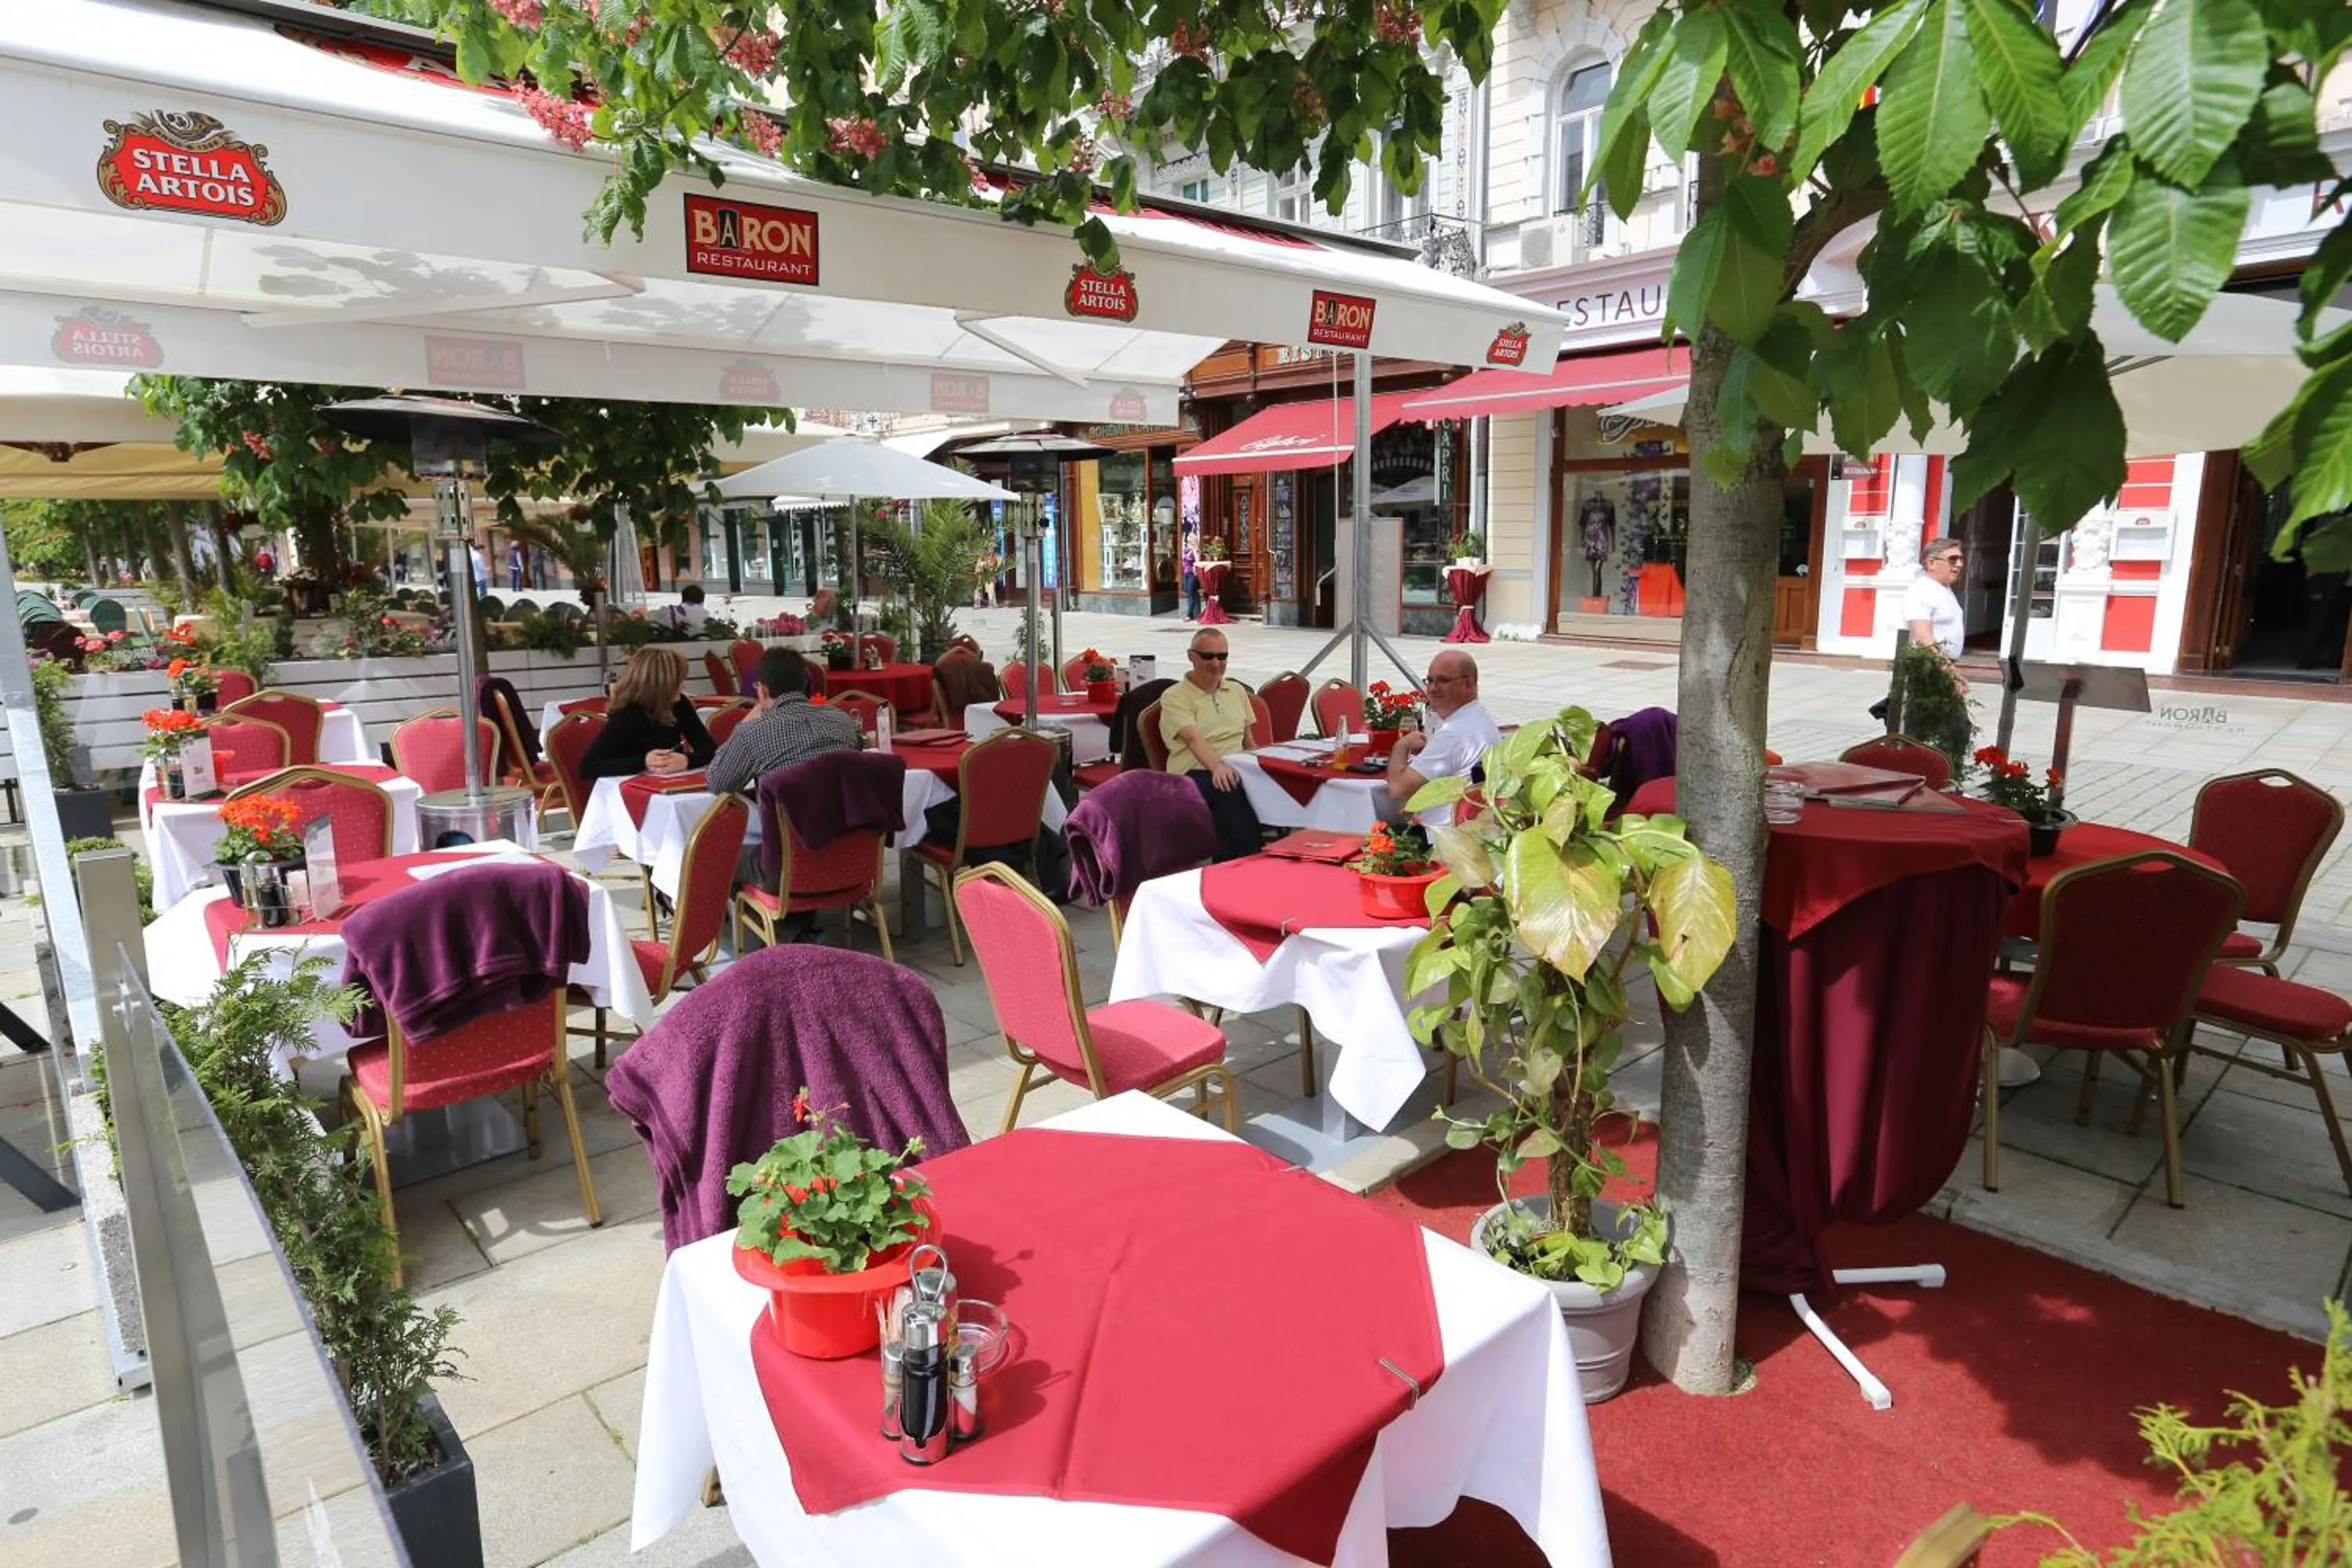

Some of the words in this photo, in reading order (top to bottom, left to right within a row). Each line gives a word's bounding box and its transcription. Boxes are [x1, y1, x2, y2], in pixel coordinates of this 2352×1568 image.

[132, 148, 250, 183] STELLA
[136, 173, 256, 206] ARTOIS
[693, 209, 811, 258] BARON
[697, 252, 811, 276] RESTAURANT
[1079, 294, 1127, 310] ARTOIS
[1080, 280, 1127, 296] STELLA
[1314, 299, 1372, 329] BARON
